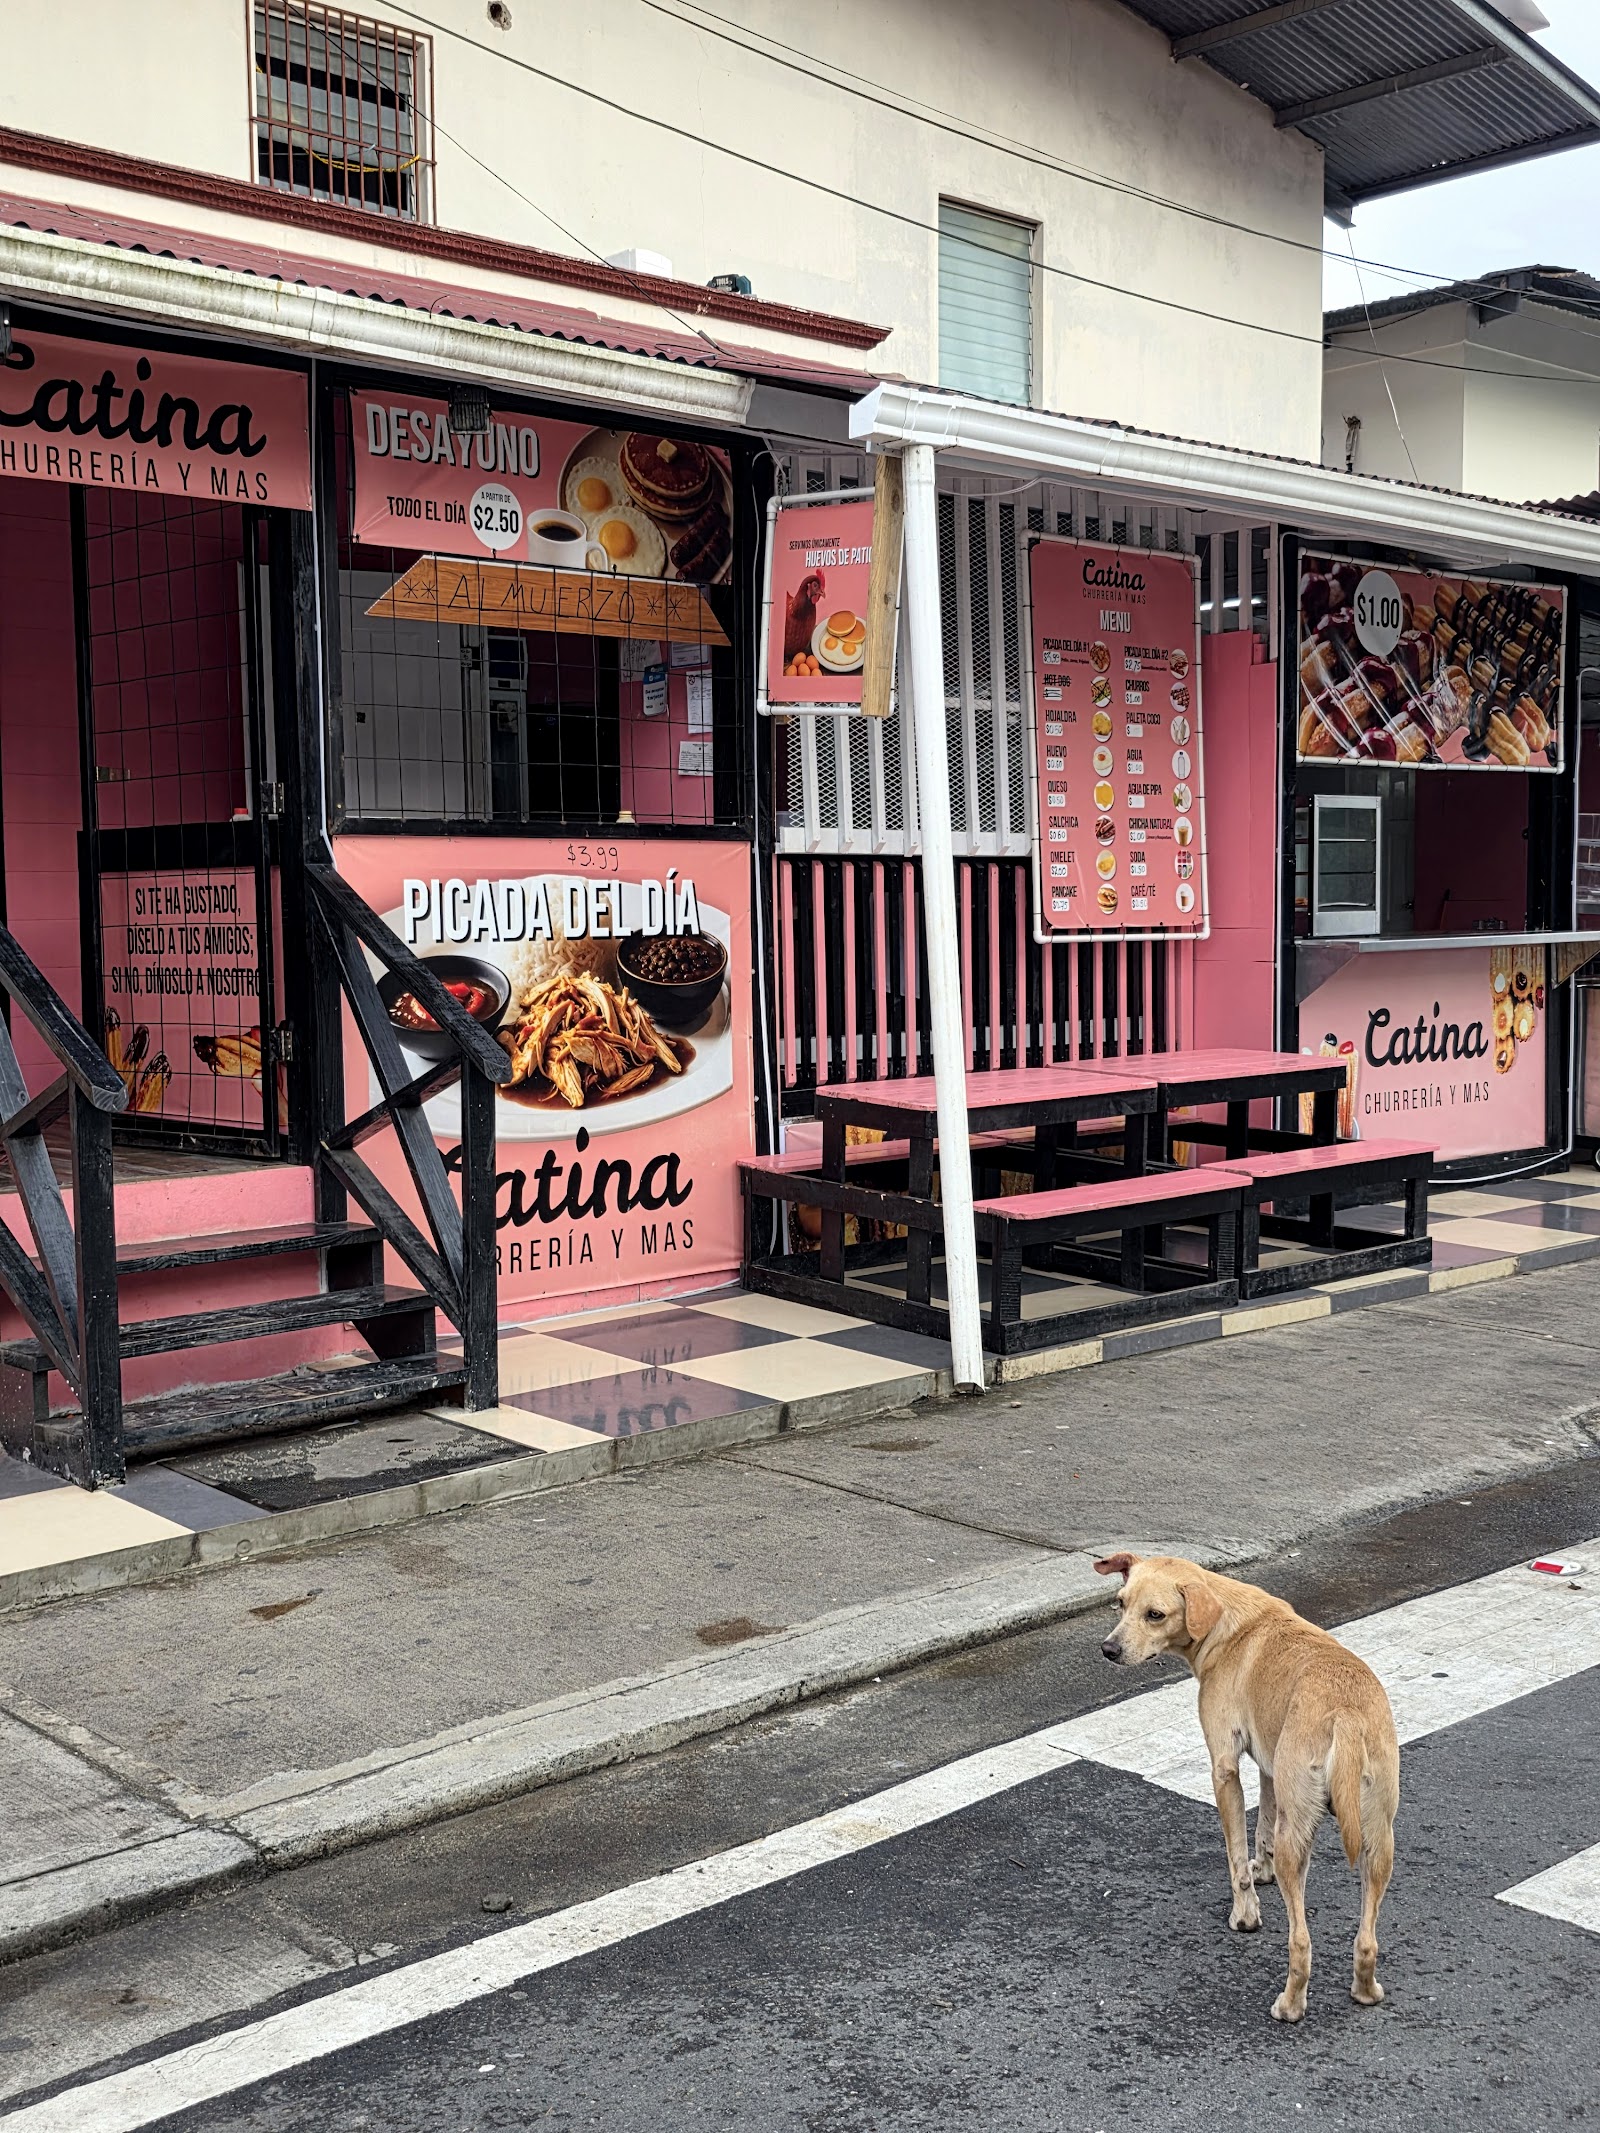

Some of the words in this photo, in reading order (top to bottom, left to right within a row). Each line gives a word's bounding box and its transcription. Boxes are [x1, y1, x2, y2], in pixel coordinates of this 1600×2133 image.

[0, 341, 267, 457] Catina
[365, 403, 540, 479] DESAYUNO
[1, 439, 160, 488] HURRERÍA
[177, 462, 191, 491] Y
[210, 466, 269, 501] MAS
[486, 492, 504, 502] PARTIR
[504, 494, 511, 504] DE
[386, 496, 422, 519] TODO
[425, 501, 442, 522] EL
[445, 501, 467, 525] DÍA
[473, 503, 519, 534] $2.50
[789, 539, 812, 550] SERVIMOS
[805, 549, 837, 568] HUEVOS
[838, 548, 850, 566] DE
[1082, 558, 1146, 591] Catina
[1082, 587, 1122, 601] CHURRERÍA
[1125, 592, 1129, 603] Y
[1131, 594, 1146, 605] MAS
[1357, 591, 1400, 629] $1.00
[1100, 610, 1132, 634] MENU
[1042, 638, 1062, 650] PICADA
[1062, 640, 1073, 652] DEL
[1073, 638, 1082, 652] DÍA
[1124, 646, 1141, 658] PICADA
[1142, 647, 1152, 659] DEL
[1152, 646, 1160, 660] DÍA
[1125, 659, 1141, 672] $2.75
[1125, 679, 1150, 692] CHURROS
[1045, 710, 1077, 722] HOJALDRA
[1126, 712, 1146, 724] PALETA
[1146, 714, 1160, 725] COCO
[1046, 744, 1068, 758] HUEVO
[1126, 748, 1142, 761] AGUA
[1048, 780, 1068, 793] QUESO
[1128, 783, 1142, 795] AGUA
[1142, 784, 1150, 795] DE
[1150, 784, 1162, 796] PIPA
[1048, 816, 1079, 828] SALCHICA
[1128, 818, 1149, 830] CHICHA
[1150, 818, 1174, 830] NATURAL
[567, 844, 619, 871] $3.99
[1050, 851, 1075, 863] OMELET
[1130, 851, 1146, 863] SODA
[1052, 886, 1078, 898] PANCAKE
[1130, 883, 1156, 897] CAFÉ/TÉ
[135, 887, 146, 916] SI
[148, 887, 163, 915] TE
[164, 886, 181, 915] HA
[183, 884, 242, 917] GUSTADO,
[403, 878, 554, 944] PICADA
[562, 879, 634, 941] DEL
[641, 868, 701, 938] DÍA
[168, 927, 176, 955] A
[178, 926, 201, 955] TUS
[204, 926, 254, 958] AMIGOS;
[111, 967, 122, 994] SI
[124, 966, 143, 997] NO,
[146, 962, 193, 995] DÍNOSLO
[196, 968, 204, 996] A
[206, 968, 260, 996] NOSOTRO
[1364, 1001, 1489, 1068] Catina
[1365, 1084, 1443, 1115] CHURRERÍA
[1449, 1085, 1457, 1105] Y
[1463, 1081, 1490, 1104] MAS
[437, 1126, 693, 1230] atina
[611, 1233, 624, 1260] Y
[641, 1218, 695, 1255] MAS
